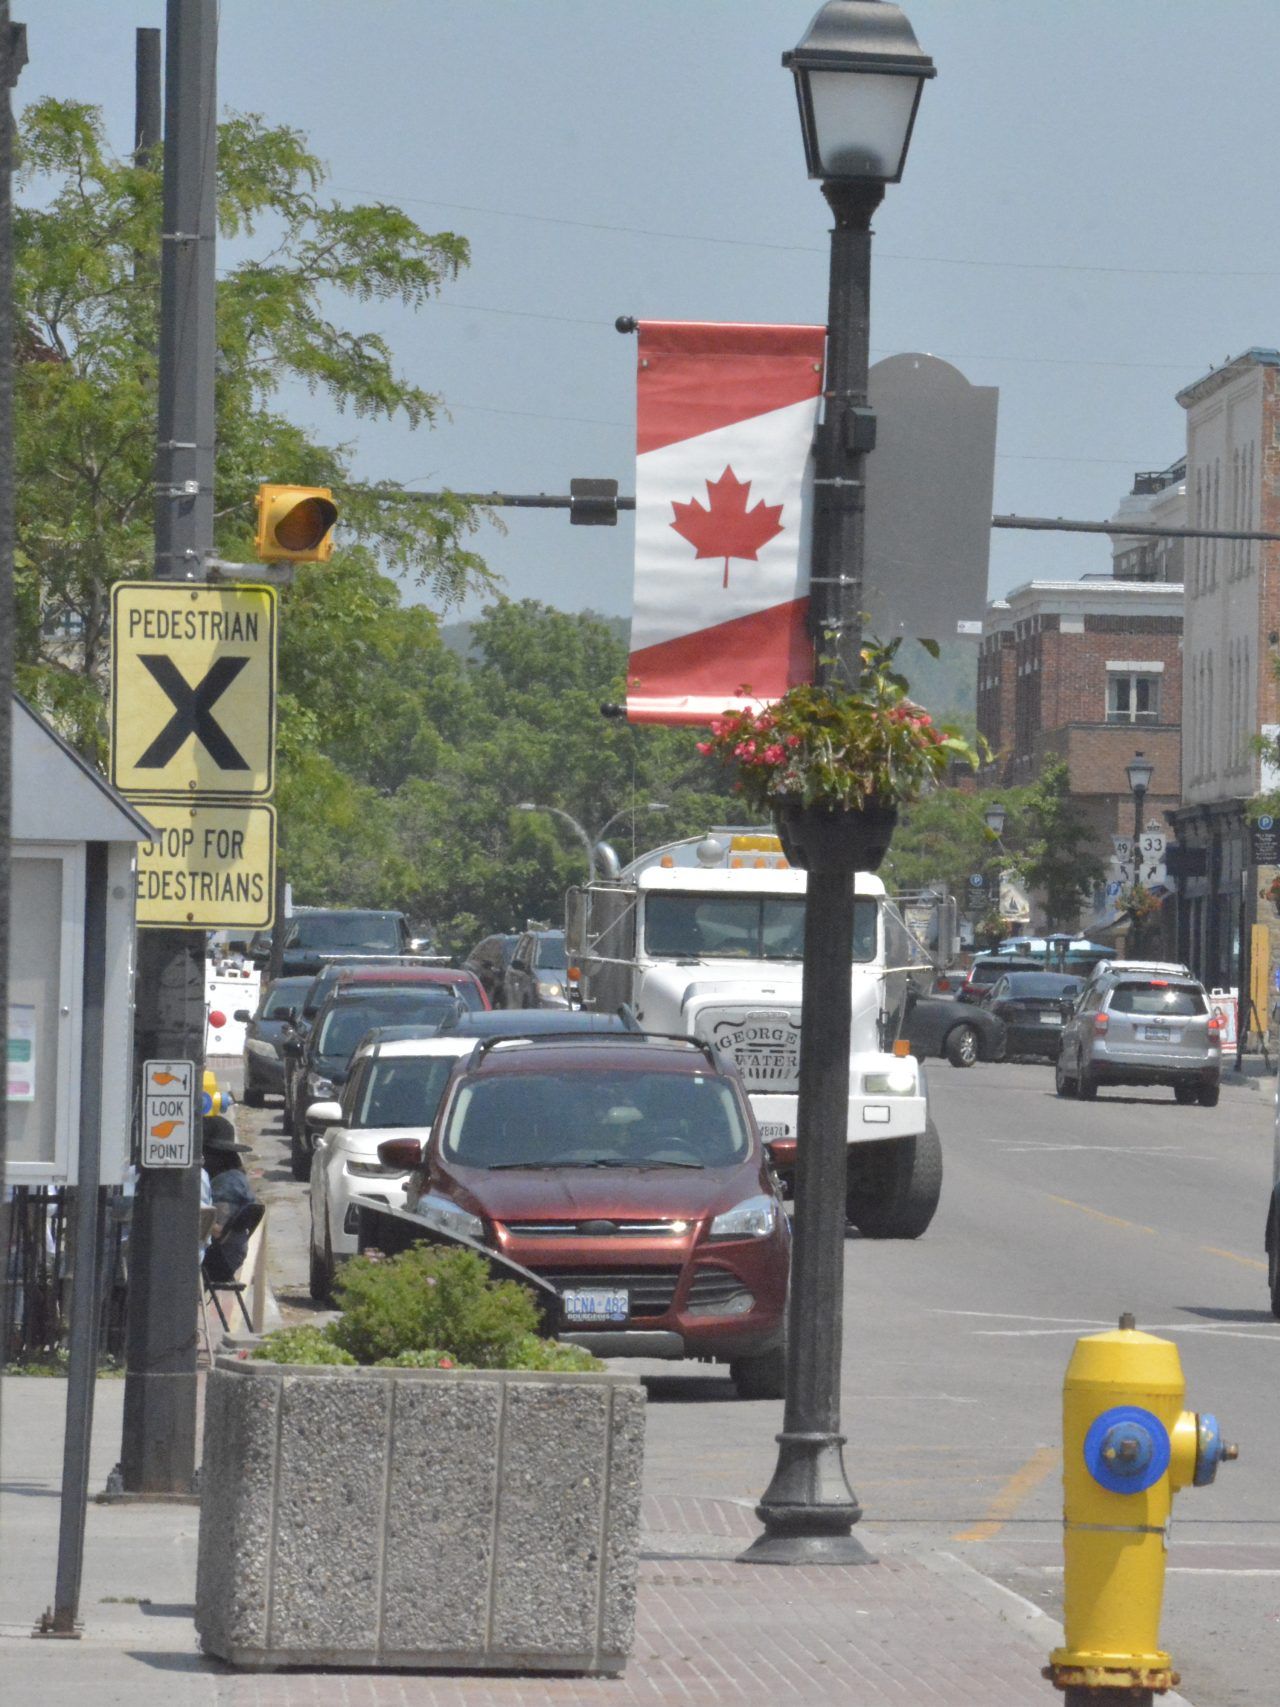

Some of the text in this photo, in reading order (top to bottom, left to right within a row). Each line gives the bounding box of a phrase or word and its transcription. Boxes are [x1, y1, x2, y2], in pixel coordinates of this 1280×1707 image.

[129, 609, 259, 642] PEDESTRIAN
[133, 654, 252, 771] X
[204, 829, 243, 859] FOR
[1117, 843, 1128, 854] 49
[1144, 838, 1163, 851] 33
[137, 870, 264, 903] EDESTRIANS
[720, 1028, 798, 1049] GEORGE
[735, 1054, 798, 1066] WATER
[152, 1101, 184, 1116] LOOK
[150, 1144, 185, 1160] POINT
